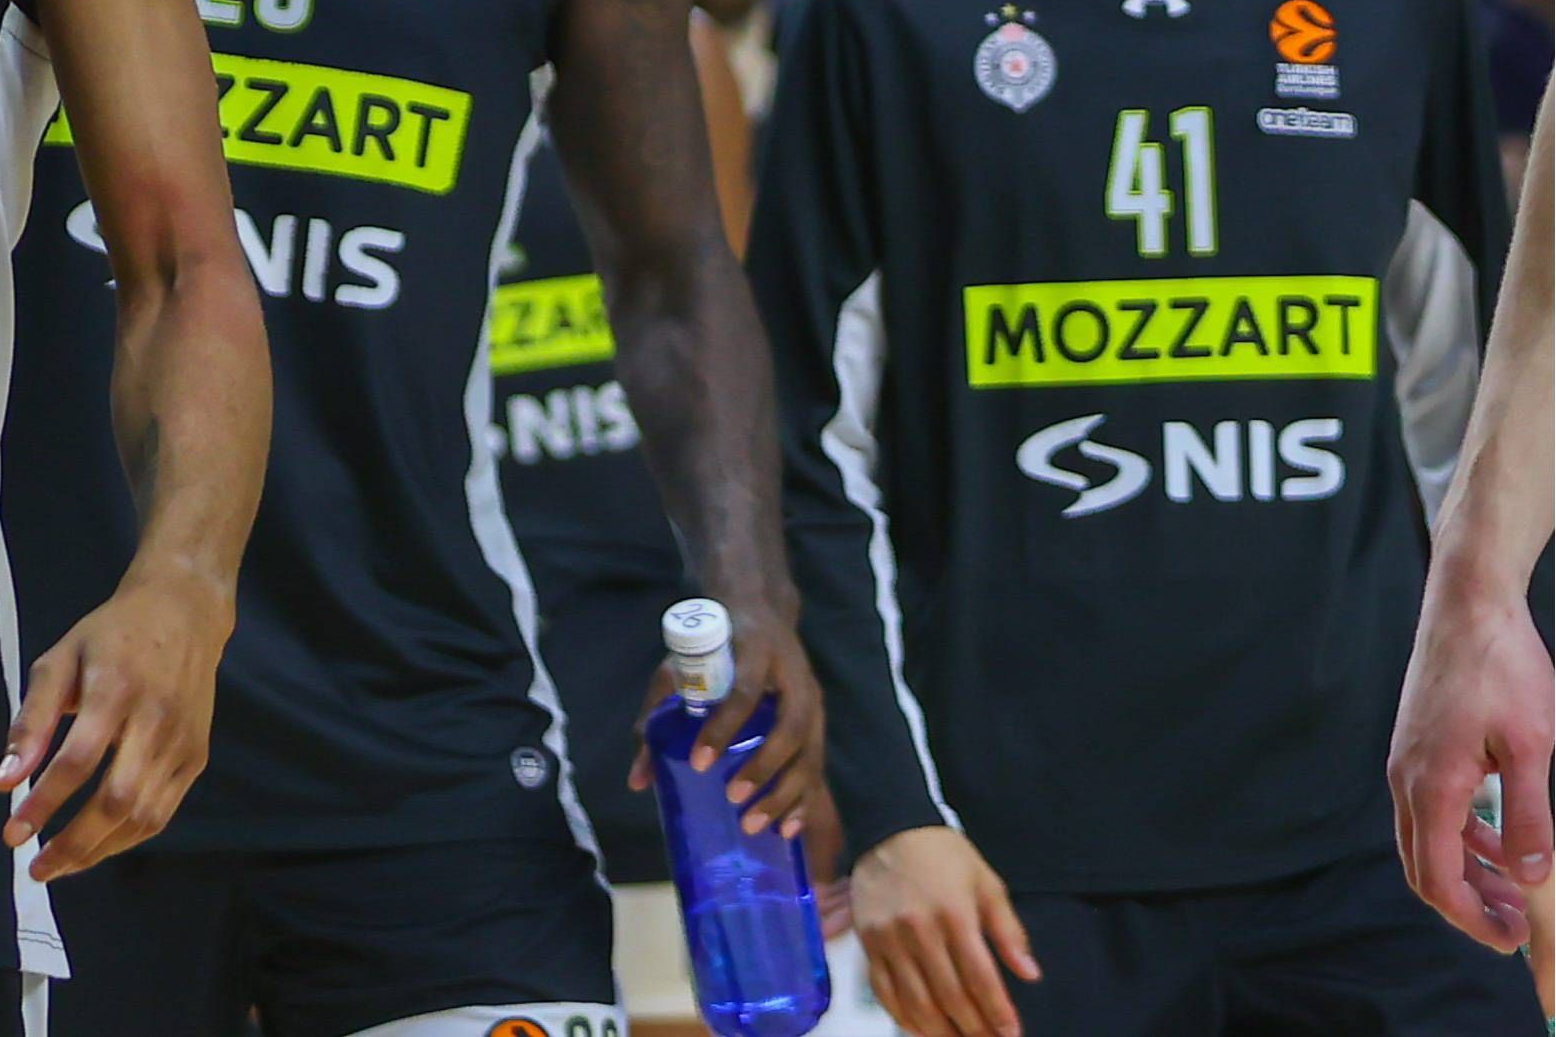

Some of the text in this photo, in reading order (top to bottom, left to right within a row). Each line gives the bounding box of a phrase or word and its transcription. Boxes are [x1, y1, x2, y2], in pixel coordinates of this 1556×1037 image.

[1105, 106, 1218, 258] 41
[233, 208, 405, 309] NIS
[985, 297, 1360, 365] MOZZART
[506, 380, 642, 465] NIS
[1163, 418, 1345, 502] NIS
